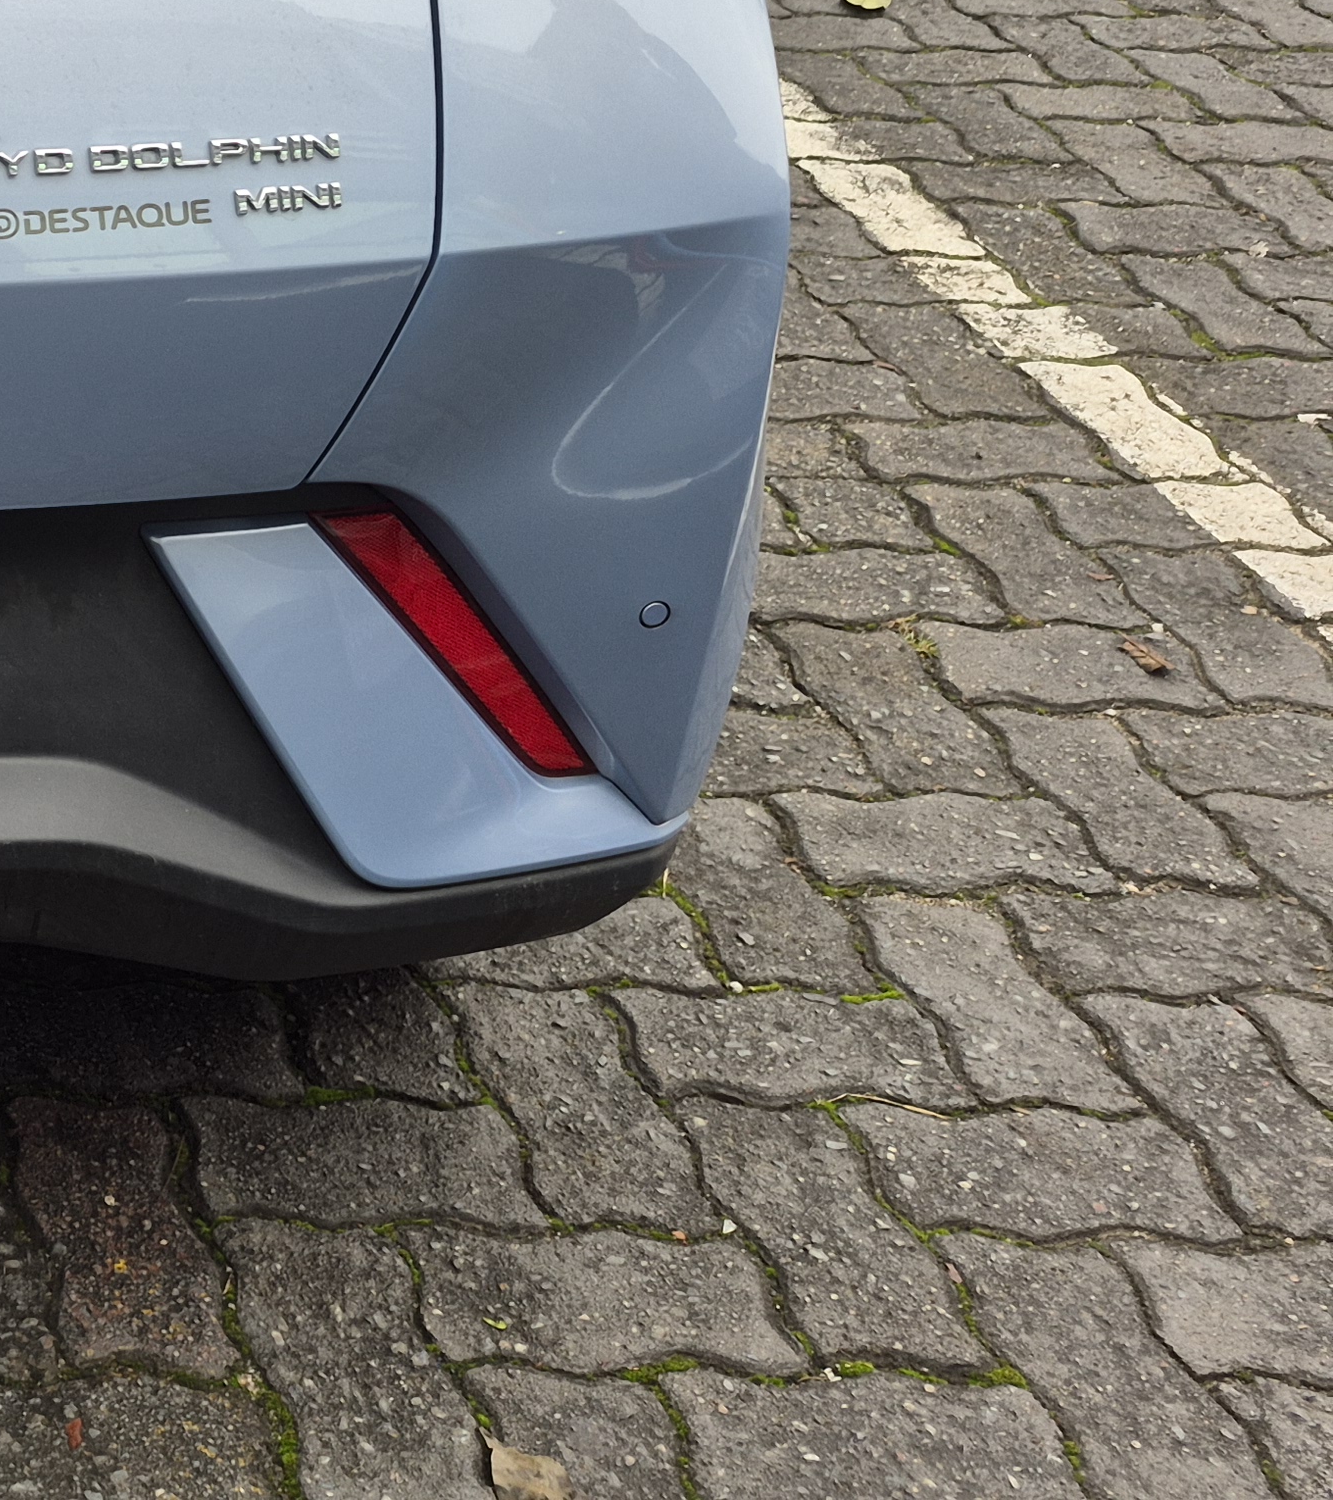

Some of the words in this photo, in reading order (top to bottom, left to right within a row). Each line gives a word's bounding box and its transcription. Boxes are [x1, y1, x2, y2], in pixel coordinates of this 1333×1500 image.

[89, 133, 341, 173] DOLPHIN
[23, 198, 212, 236] DESTAQUE
[234, 181, 343, 216] MINI
